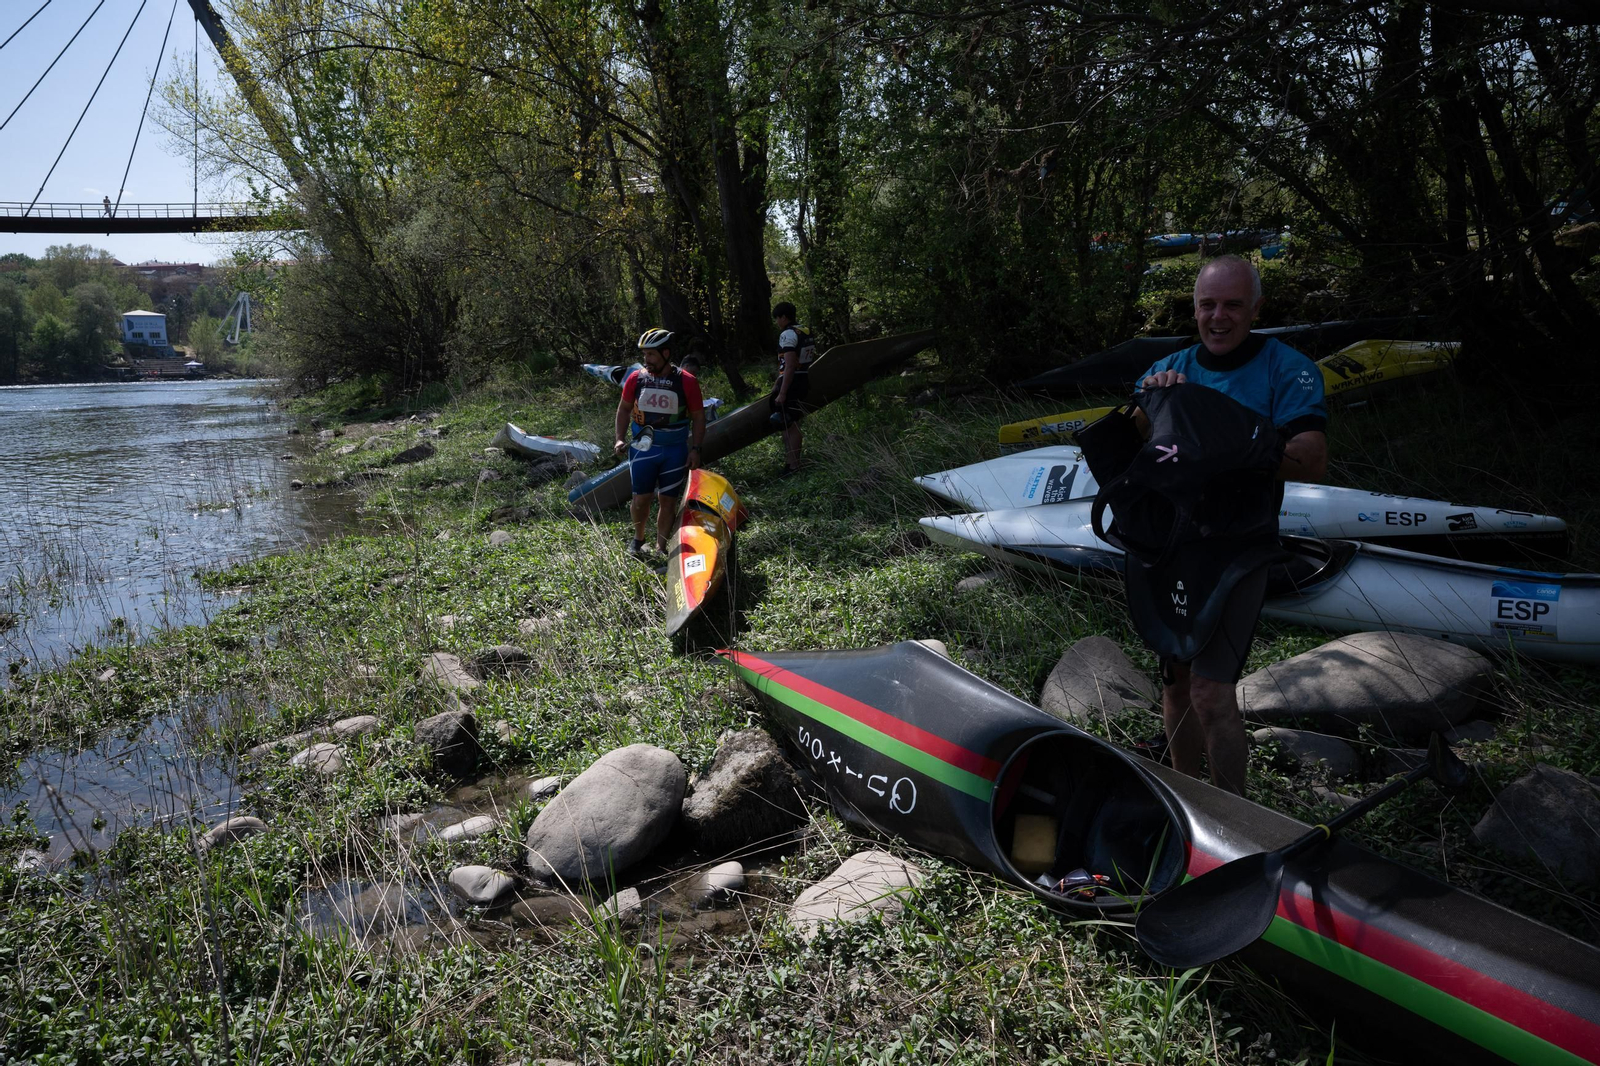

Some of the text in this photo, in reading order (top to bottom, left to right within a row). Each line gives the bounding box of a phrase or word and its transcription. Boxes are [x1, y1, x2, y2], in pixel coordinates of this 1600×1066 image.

[646, 393, 669, 408] 46
[1057, 420, 1083, 432] ESP
[1044, 478, 1055, 503] waves
[1049, 489, 1059, 502] the
[1056, 486, 1067, 502] kick
[1385, 511, 1427, 527] ESP
[1175, 606, 1187, 617] frog
[1497, 599, 1550, 621] ESP
